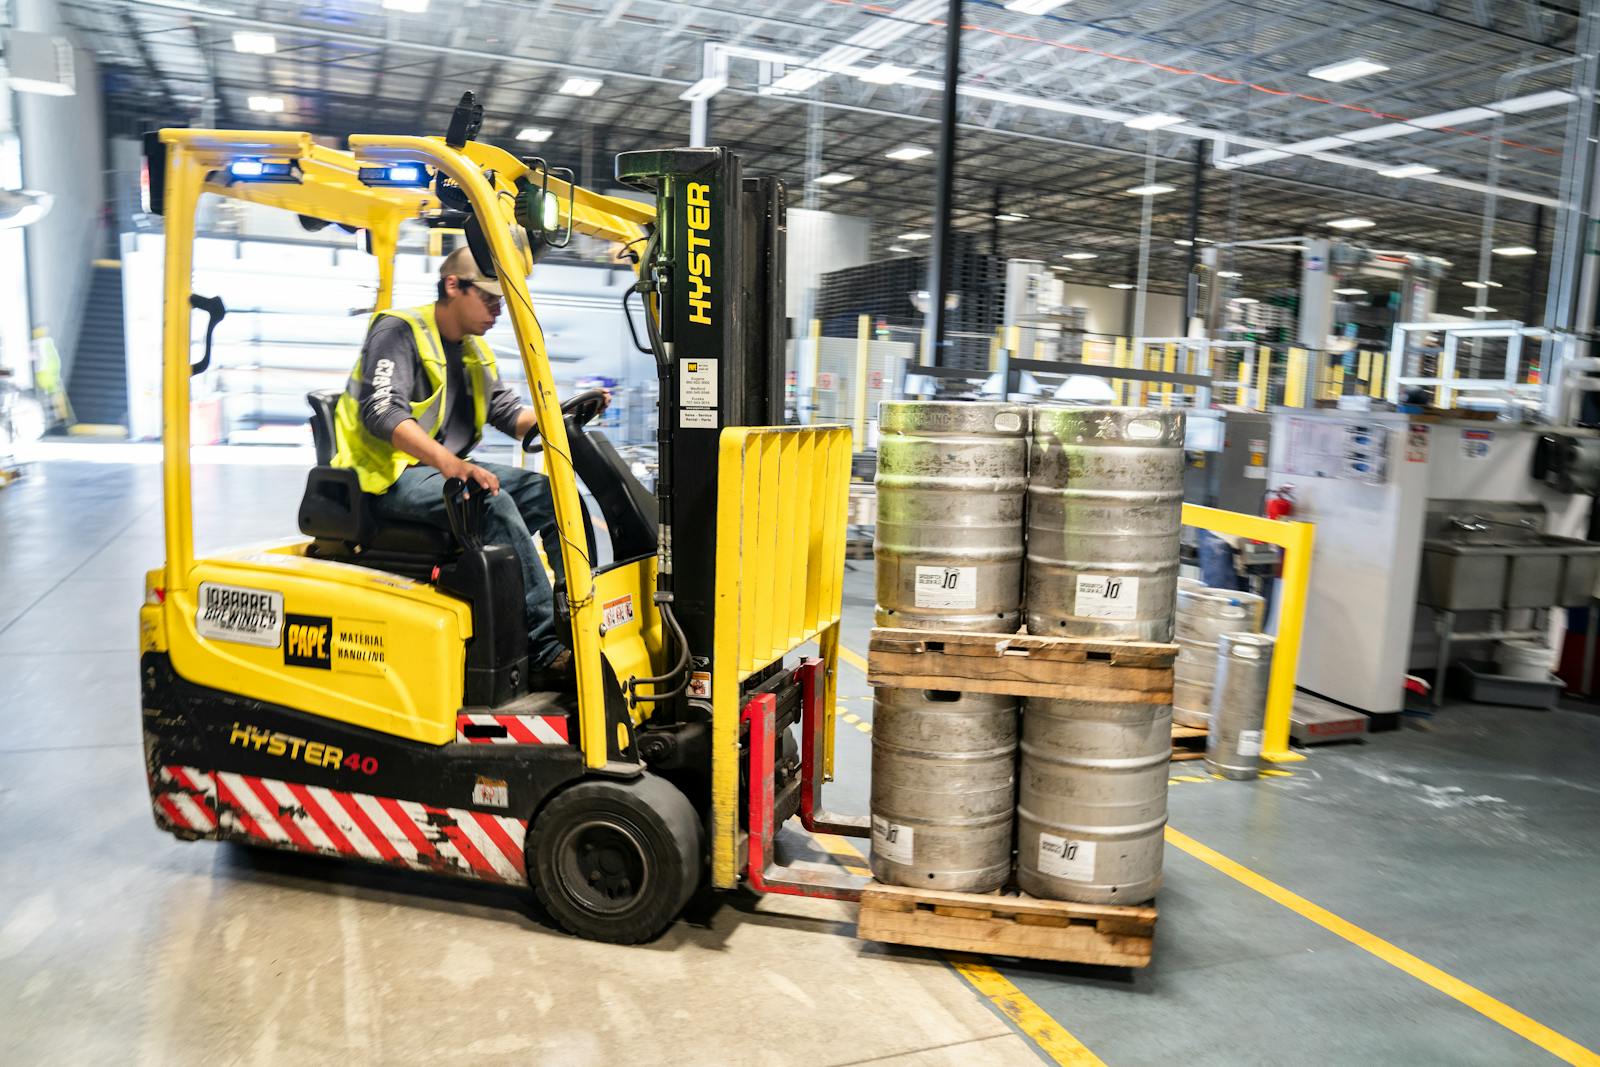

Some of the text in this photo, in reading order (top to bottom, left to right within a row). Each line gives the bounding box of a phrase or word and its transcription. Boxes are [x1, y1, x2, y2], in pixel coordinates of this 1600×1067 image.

[687, 182, 711, 325] HYSTER
[941, 571, 958, 589] 10
[1103, 581, 1120, 599] 10
[221, 590, 273, 613] BARREL
[339, 632, 384, 647] MATERIAL
[338, 648, 385, 662] HANDLING
[229, 721, 379, 775] HYSTER 40
